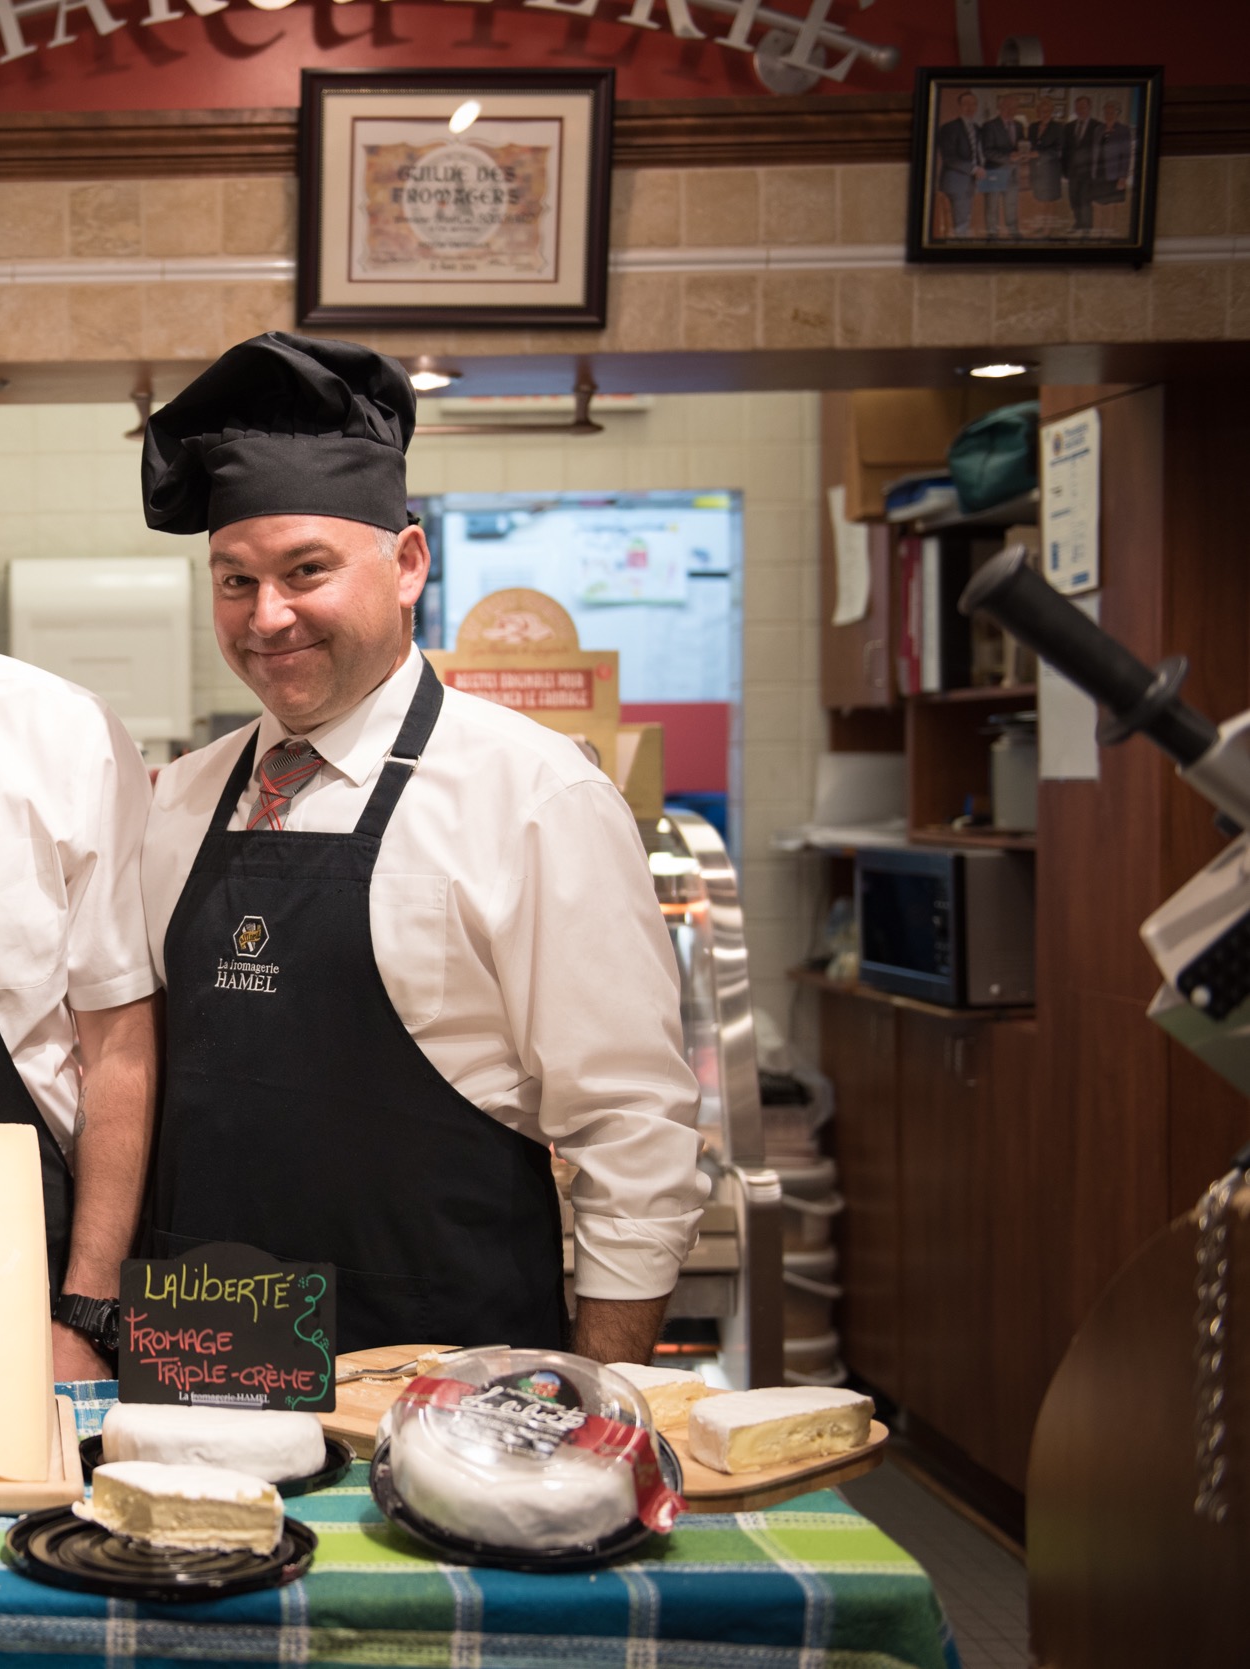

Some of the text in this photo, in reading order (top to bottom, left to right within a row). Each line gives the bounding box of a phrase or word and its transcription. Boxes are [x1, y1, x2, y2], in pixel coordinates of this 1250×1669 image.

[217, 958, 280, 974] La fromagerie
[214, 970, 277, 993] HAMEL
[124, 1306, 233, 1357] FROMAGE
[178, 1391, 190, 1402] La
[236, 1392, 270, 1404] HAMEL
